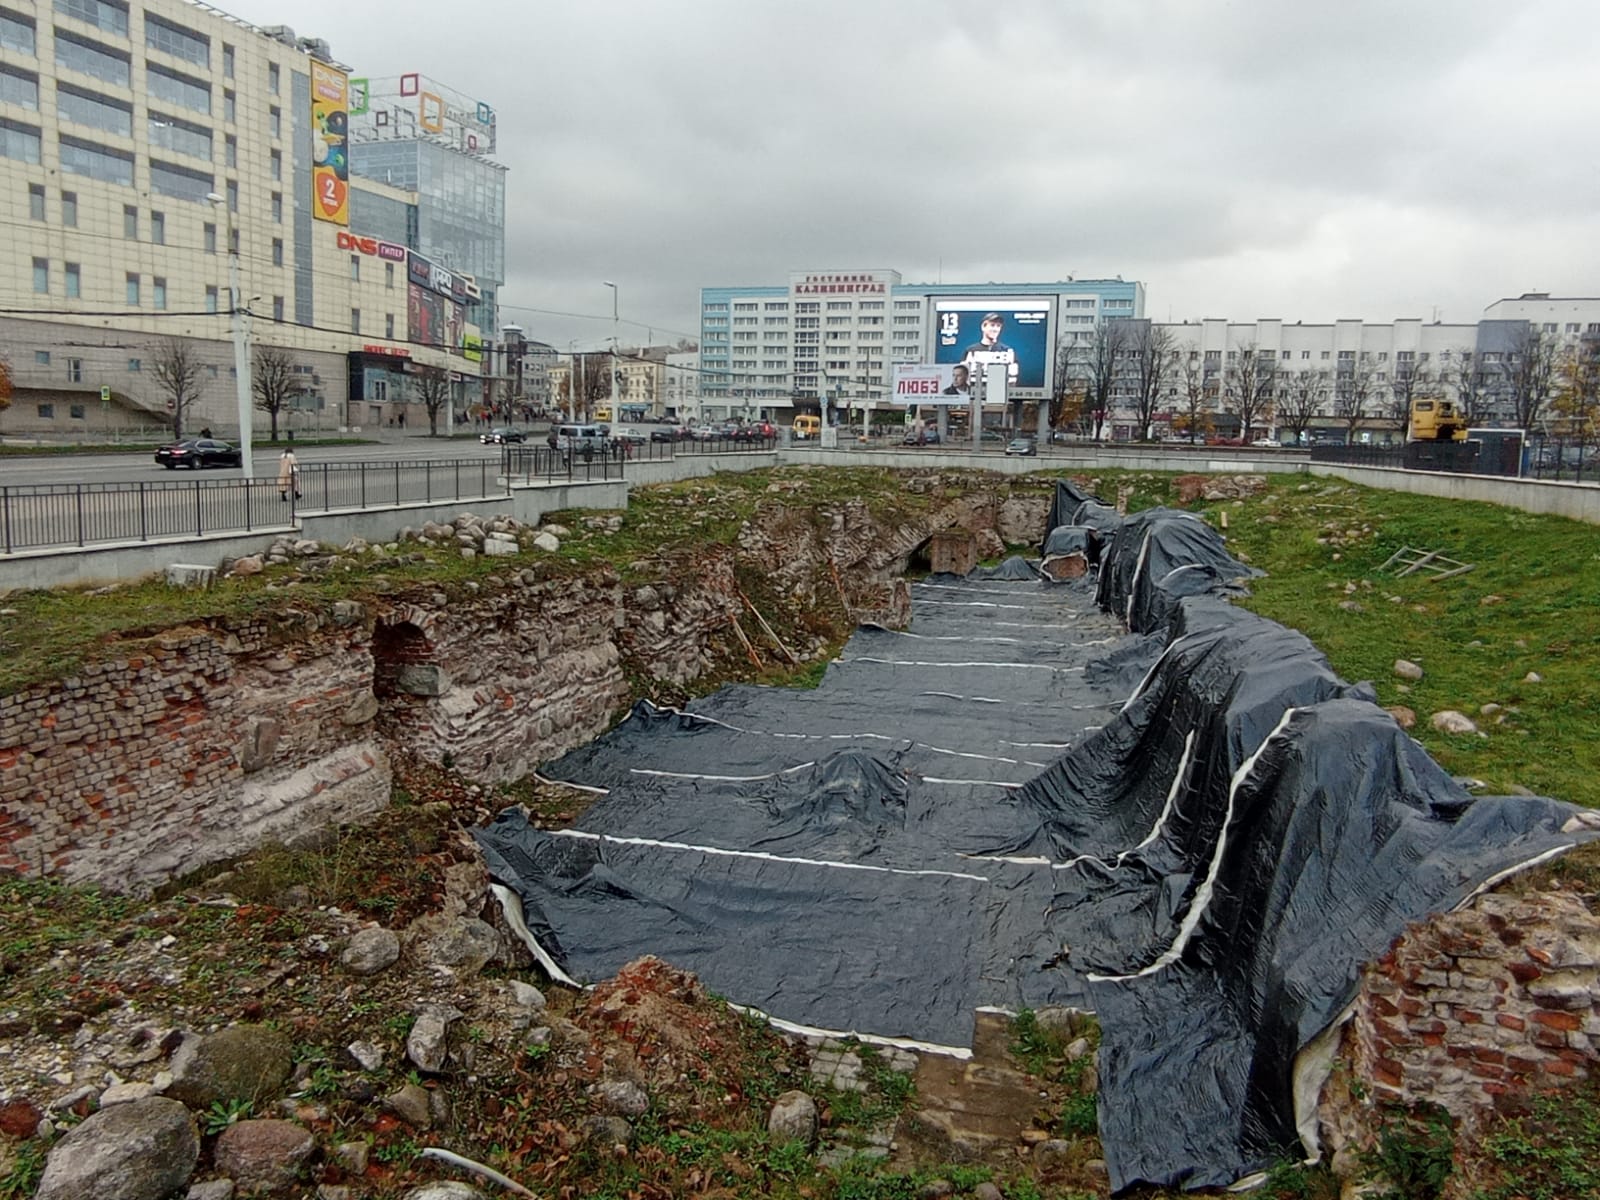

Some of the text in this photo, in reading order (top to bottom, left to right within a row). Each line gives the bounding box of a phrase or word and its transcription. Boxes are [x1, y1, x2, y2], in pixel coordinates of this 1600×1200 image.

[325, 178, 336, 197] 2
[337, 231, 377, 256] DNS
[380, 245, 404, 258] ГИПЕР
[805, 275, 874, 283] ГОСТИНИЦА
[795, 283, 886, 294] КАЛИНИНГРАД
[941, 312, 959, 330] 13
